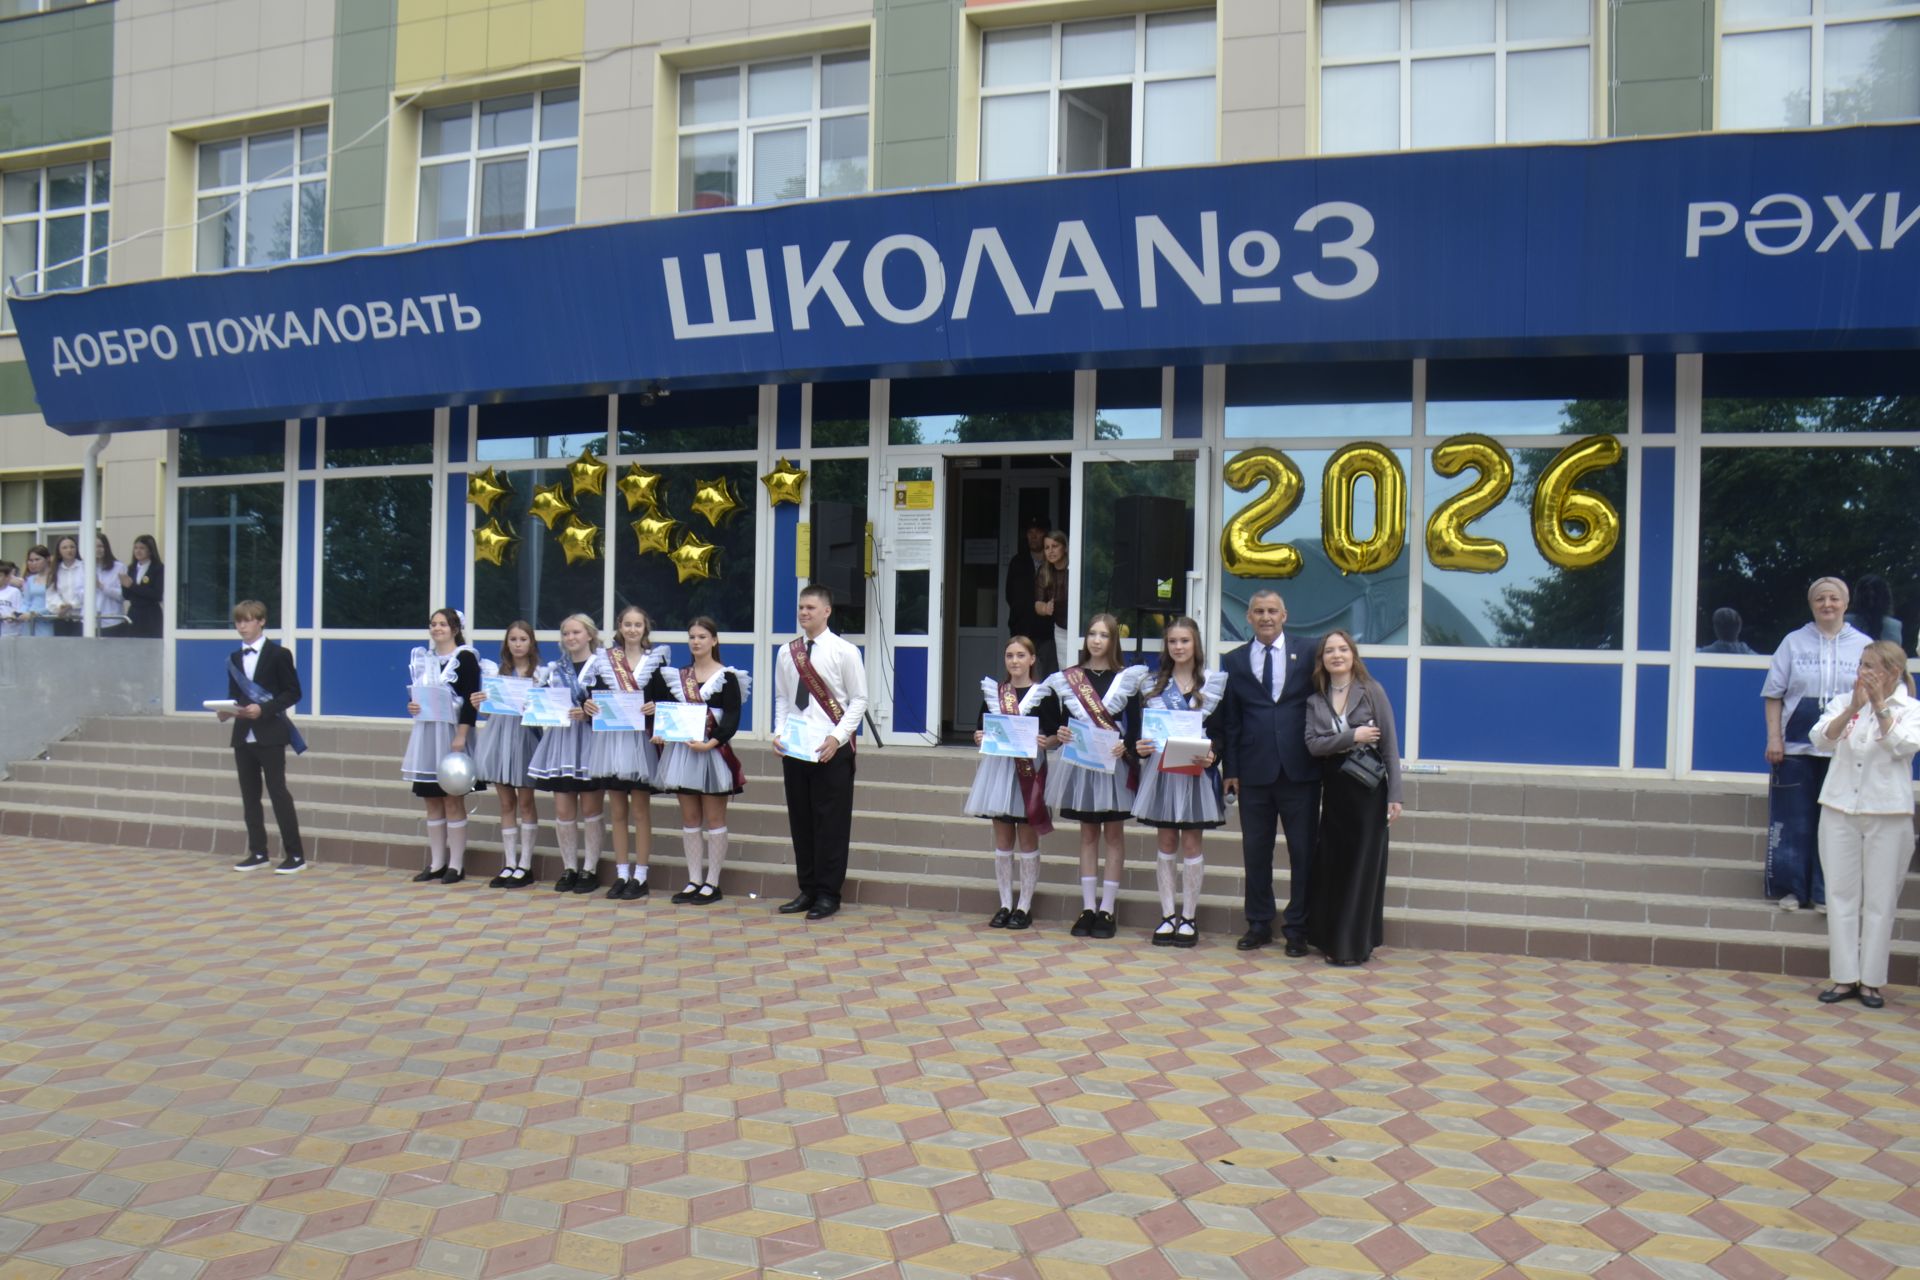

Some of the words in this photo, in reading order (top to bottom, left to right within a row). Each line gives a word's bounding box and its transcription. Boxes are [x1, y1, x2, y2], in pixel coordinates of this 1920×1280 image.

[52, 324, 179, 377] ДОБРО
[187, 292, 482, 358] ПОЖАЛОВАТЬ
[662, 219, 1124, 340] ШКОЛА
[1220, 433, 1623, 579] 2026
